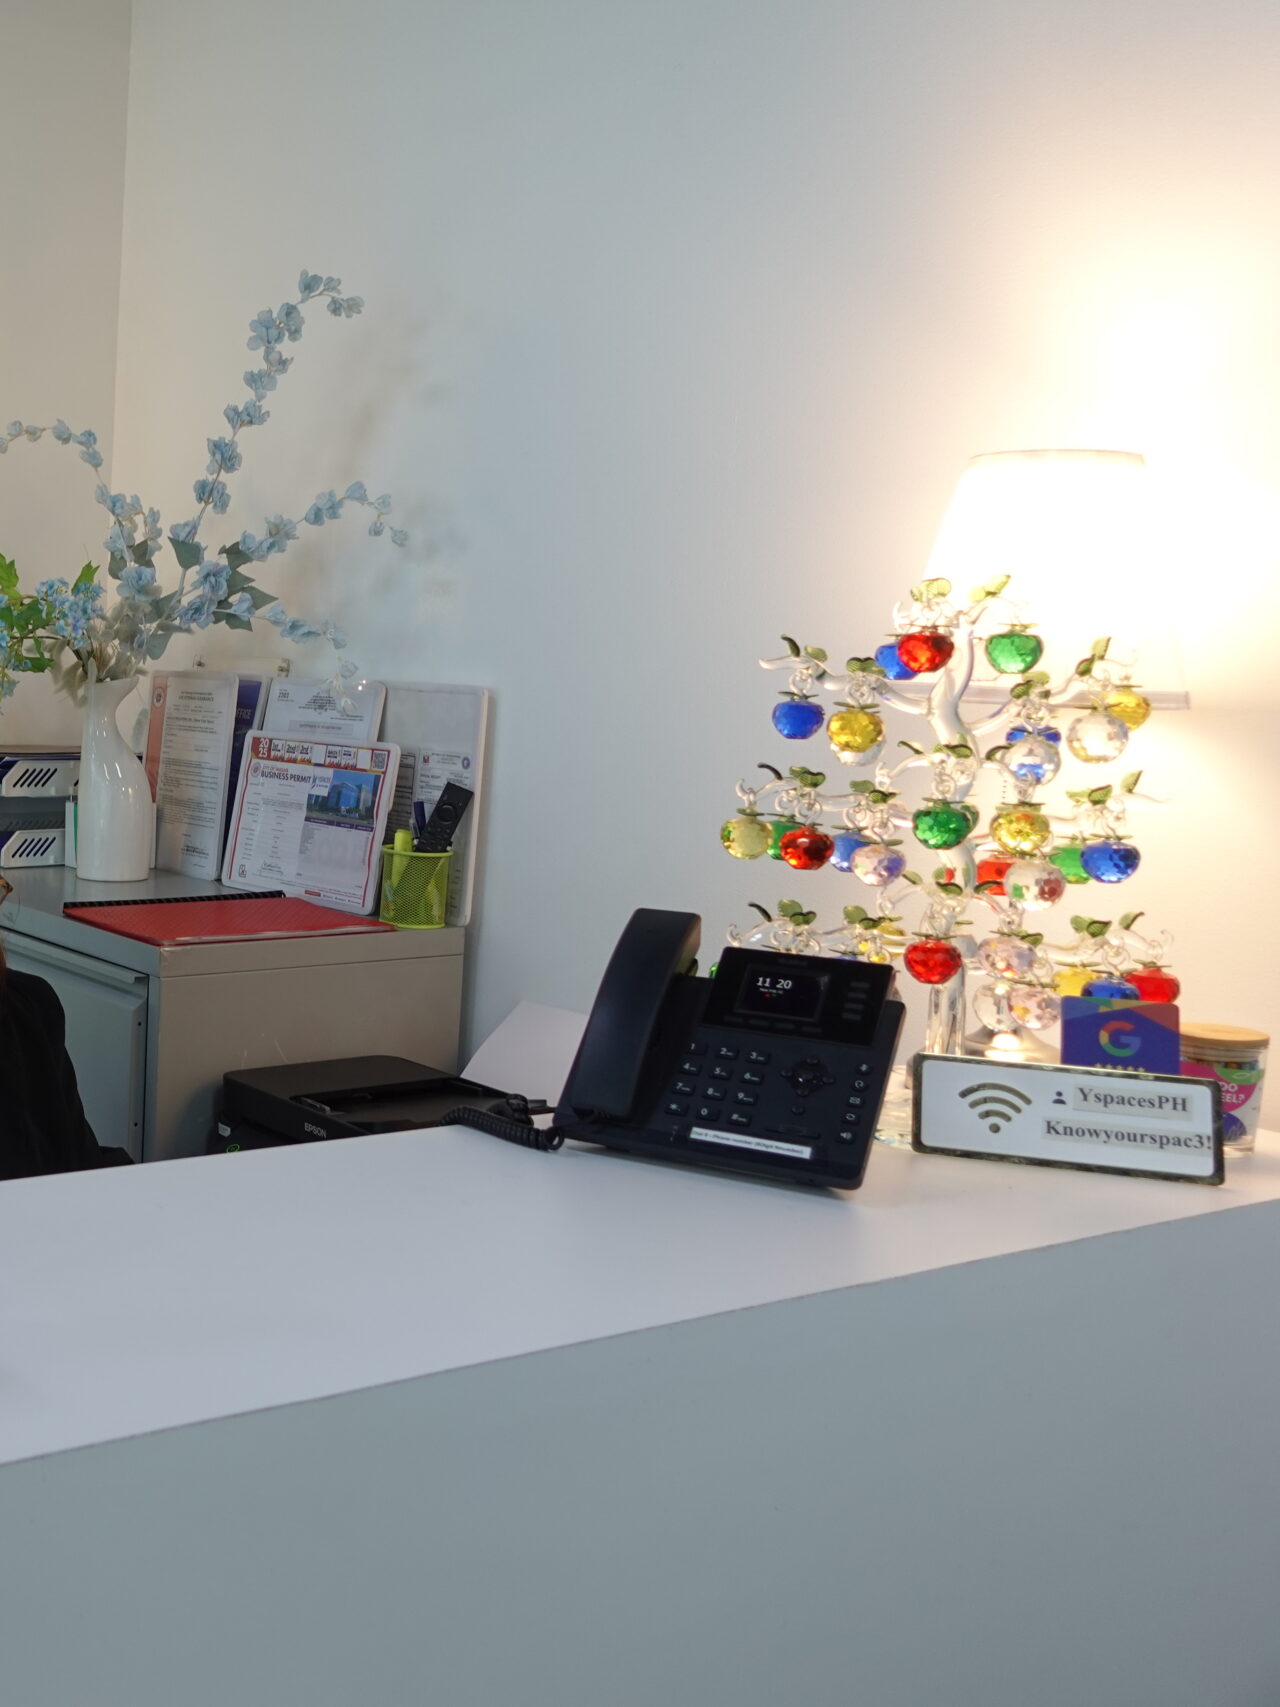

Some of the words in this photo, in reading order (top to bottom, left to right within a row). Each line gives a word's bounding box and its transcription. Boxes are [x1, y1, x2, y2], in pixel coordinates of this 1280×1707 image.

[260, 737, 269, 748] 20
[259, 747, 268, 758] 25
[261, 771, 289, 781] BUSINESS
[290, 774, 312, 784] PERMIT
[775, 978, 792, 990] 20
[1078, 1087, 1188, 1112] YspacesPH
[304, 1122, 327, 1138] EPSON
[1045, 1120, 1212, 1150] Knowyourspac3!
